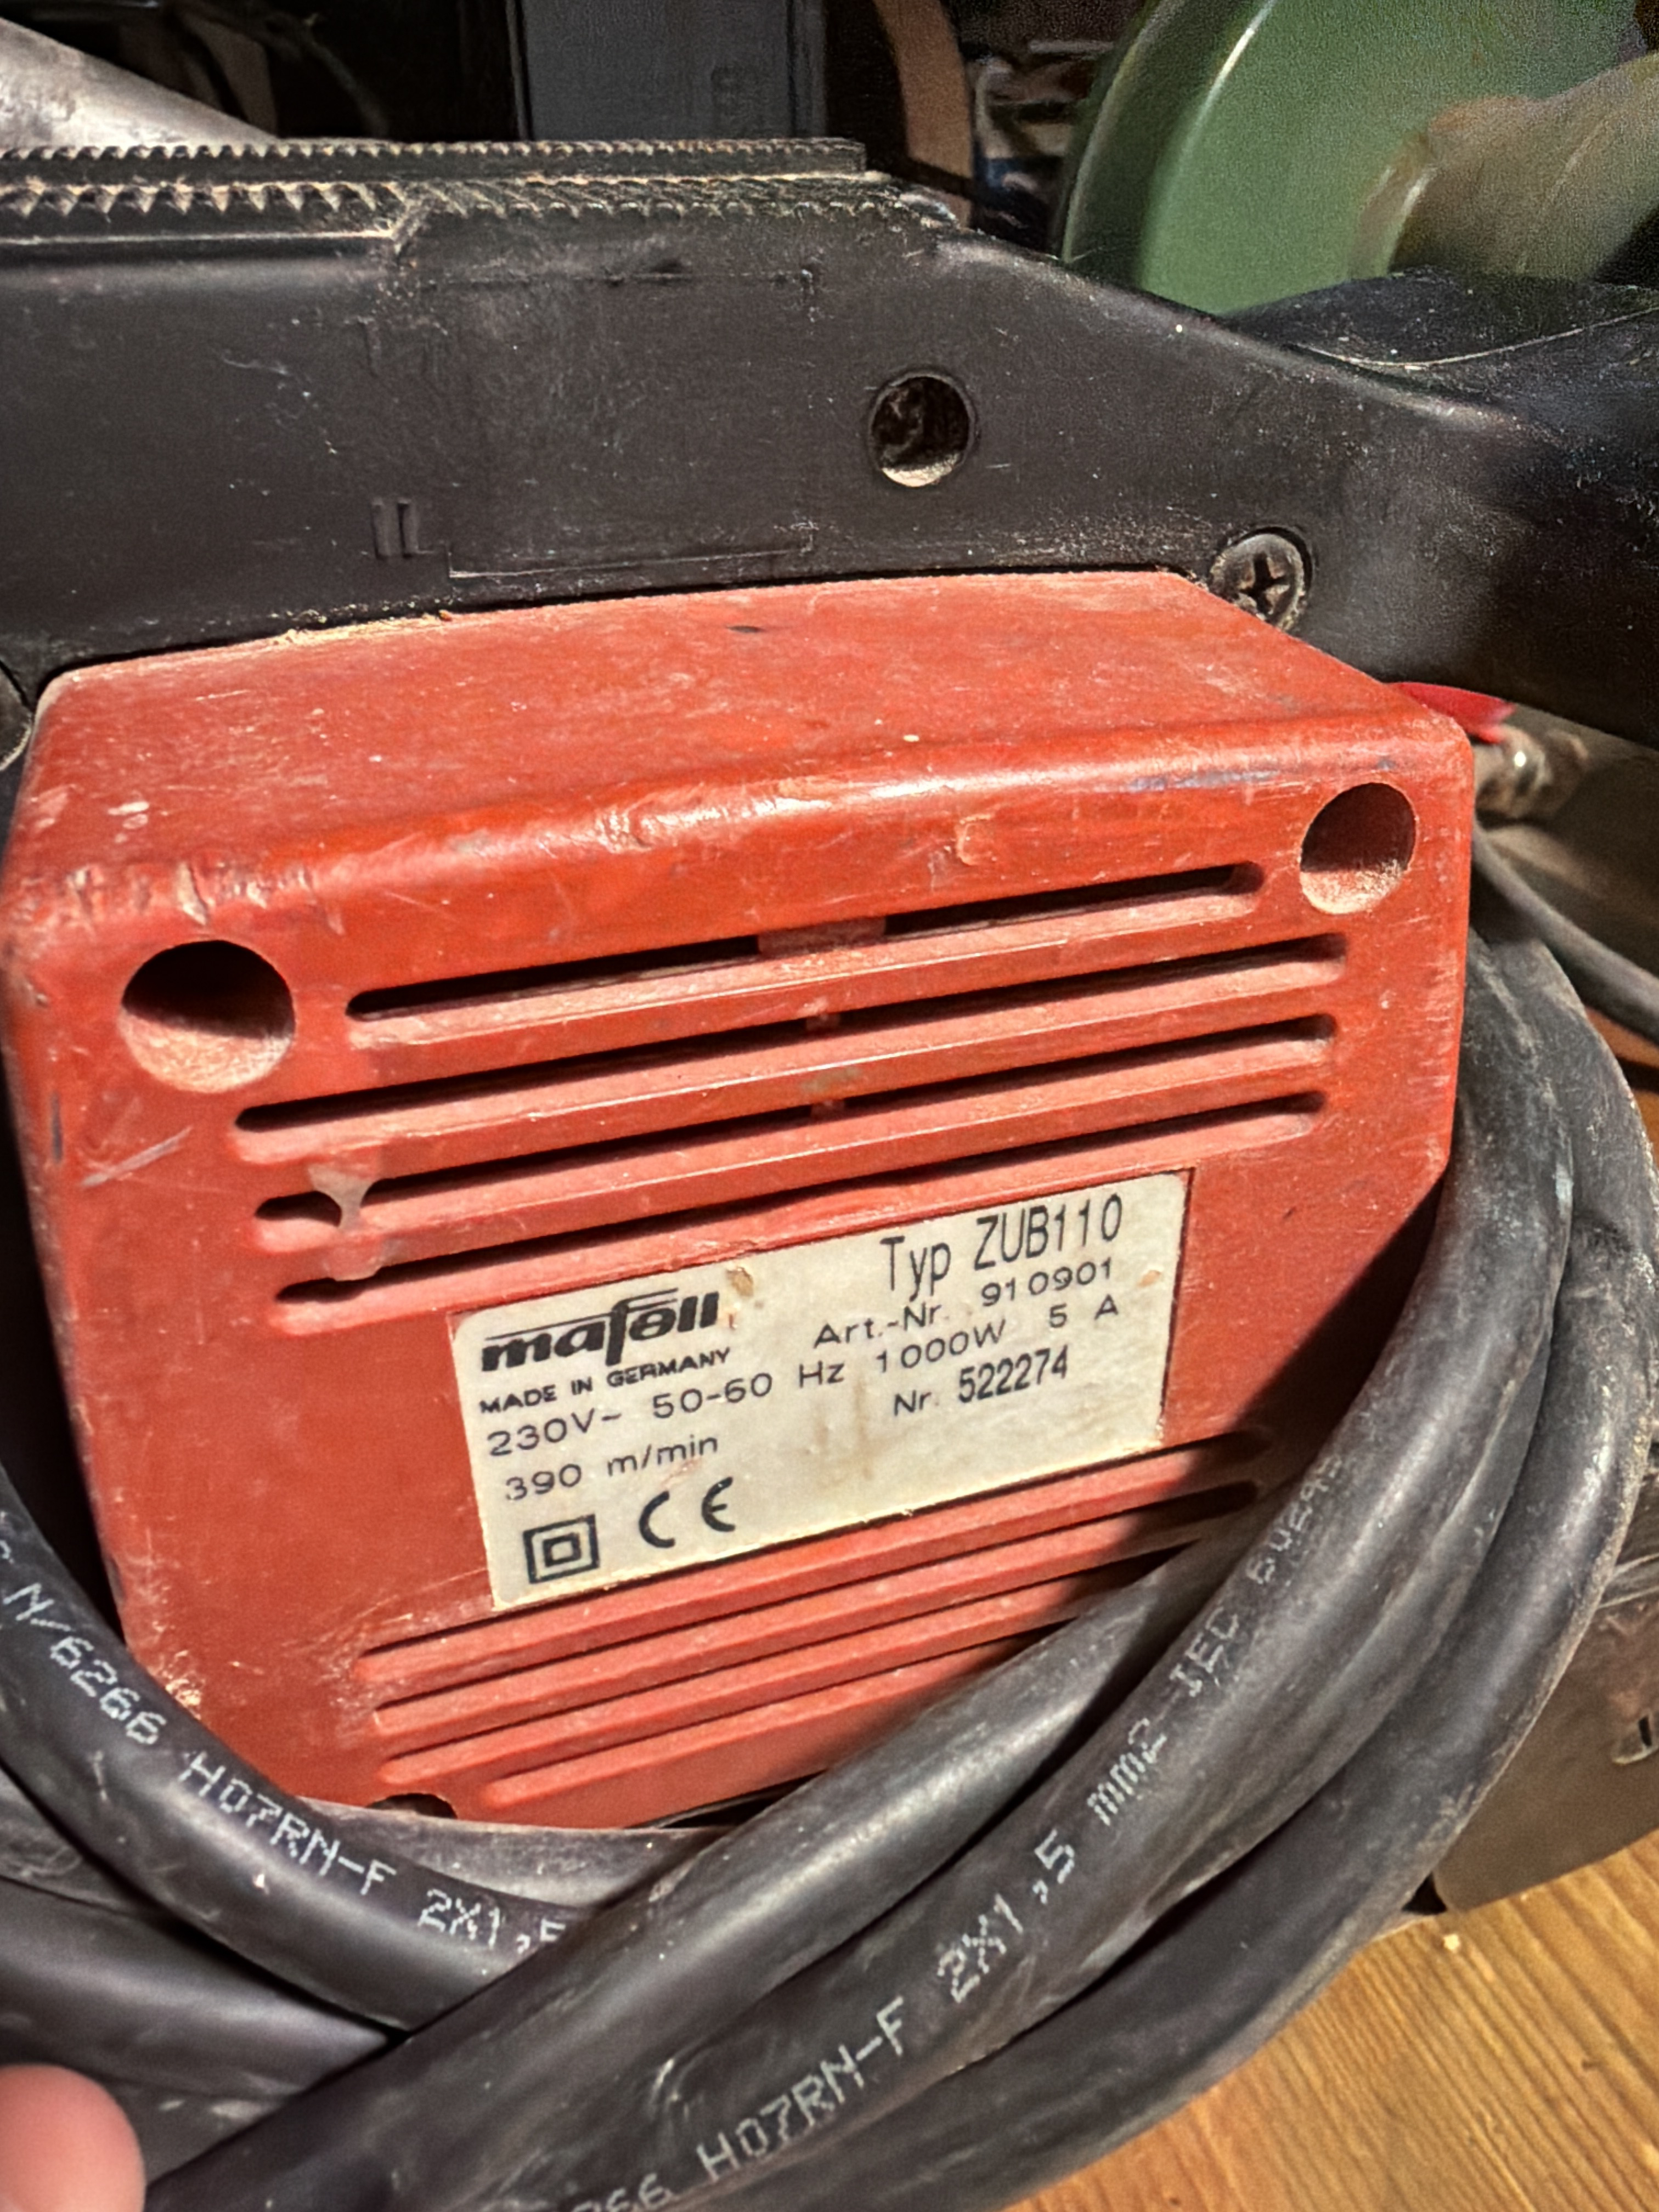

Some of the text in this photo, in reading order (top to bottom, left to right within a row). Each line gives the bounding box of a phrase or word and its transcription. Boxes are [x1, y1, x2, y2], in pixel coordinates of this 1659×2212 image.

[879, 1193, 1123, 1302] Typ ZUB110
[981, 1256, 1112, 1307] 910901
[481, 1288, 720, 1372] mafell
[652, 1372, 773, 1419] 50-60
[799, 1360, 845, 1389] Hz
[876, 1318, 1006, 1373] 1000W
[1049, 1302, 1068, 1329] 5
[1093, 1294, 1119, 1321] A
[479, 1347, 731, 1414] MADE IN GERMANY
[958, 1345, 1069, 1403] 522274
[504, 1434, 719, 1502] 390 m/min
[178, 1751, 397, 1896] H07RN-F
[696, 1995, 905, 2183] H07RN-F
[1169, 1606, 1240, 1697] IEC
